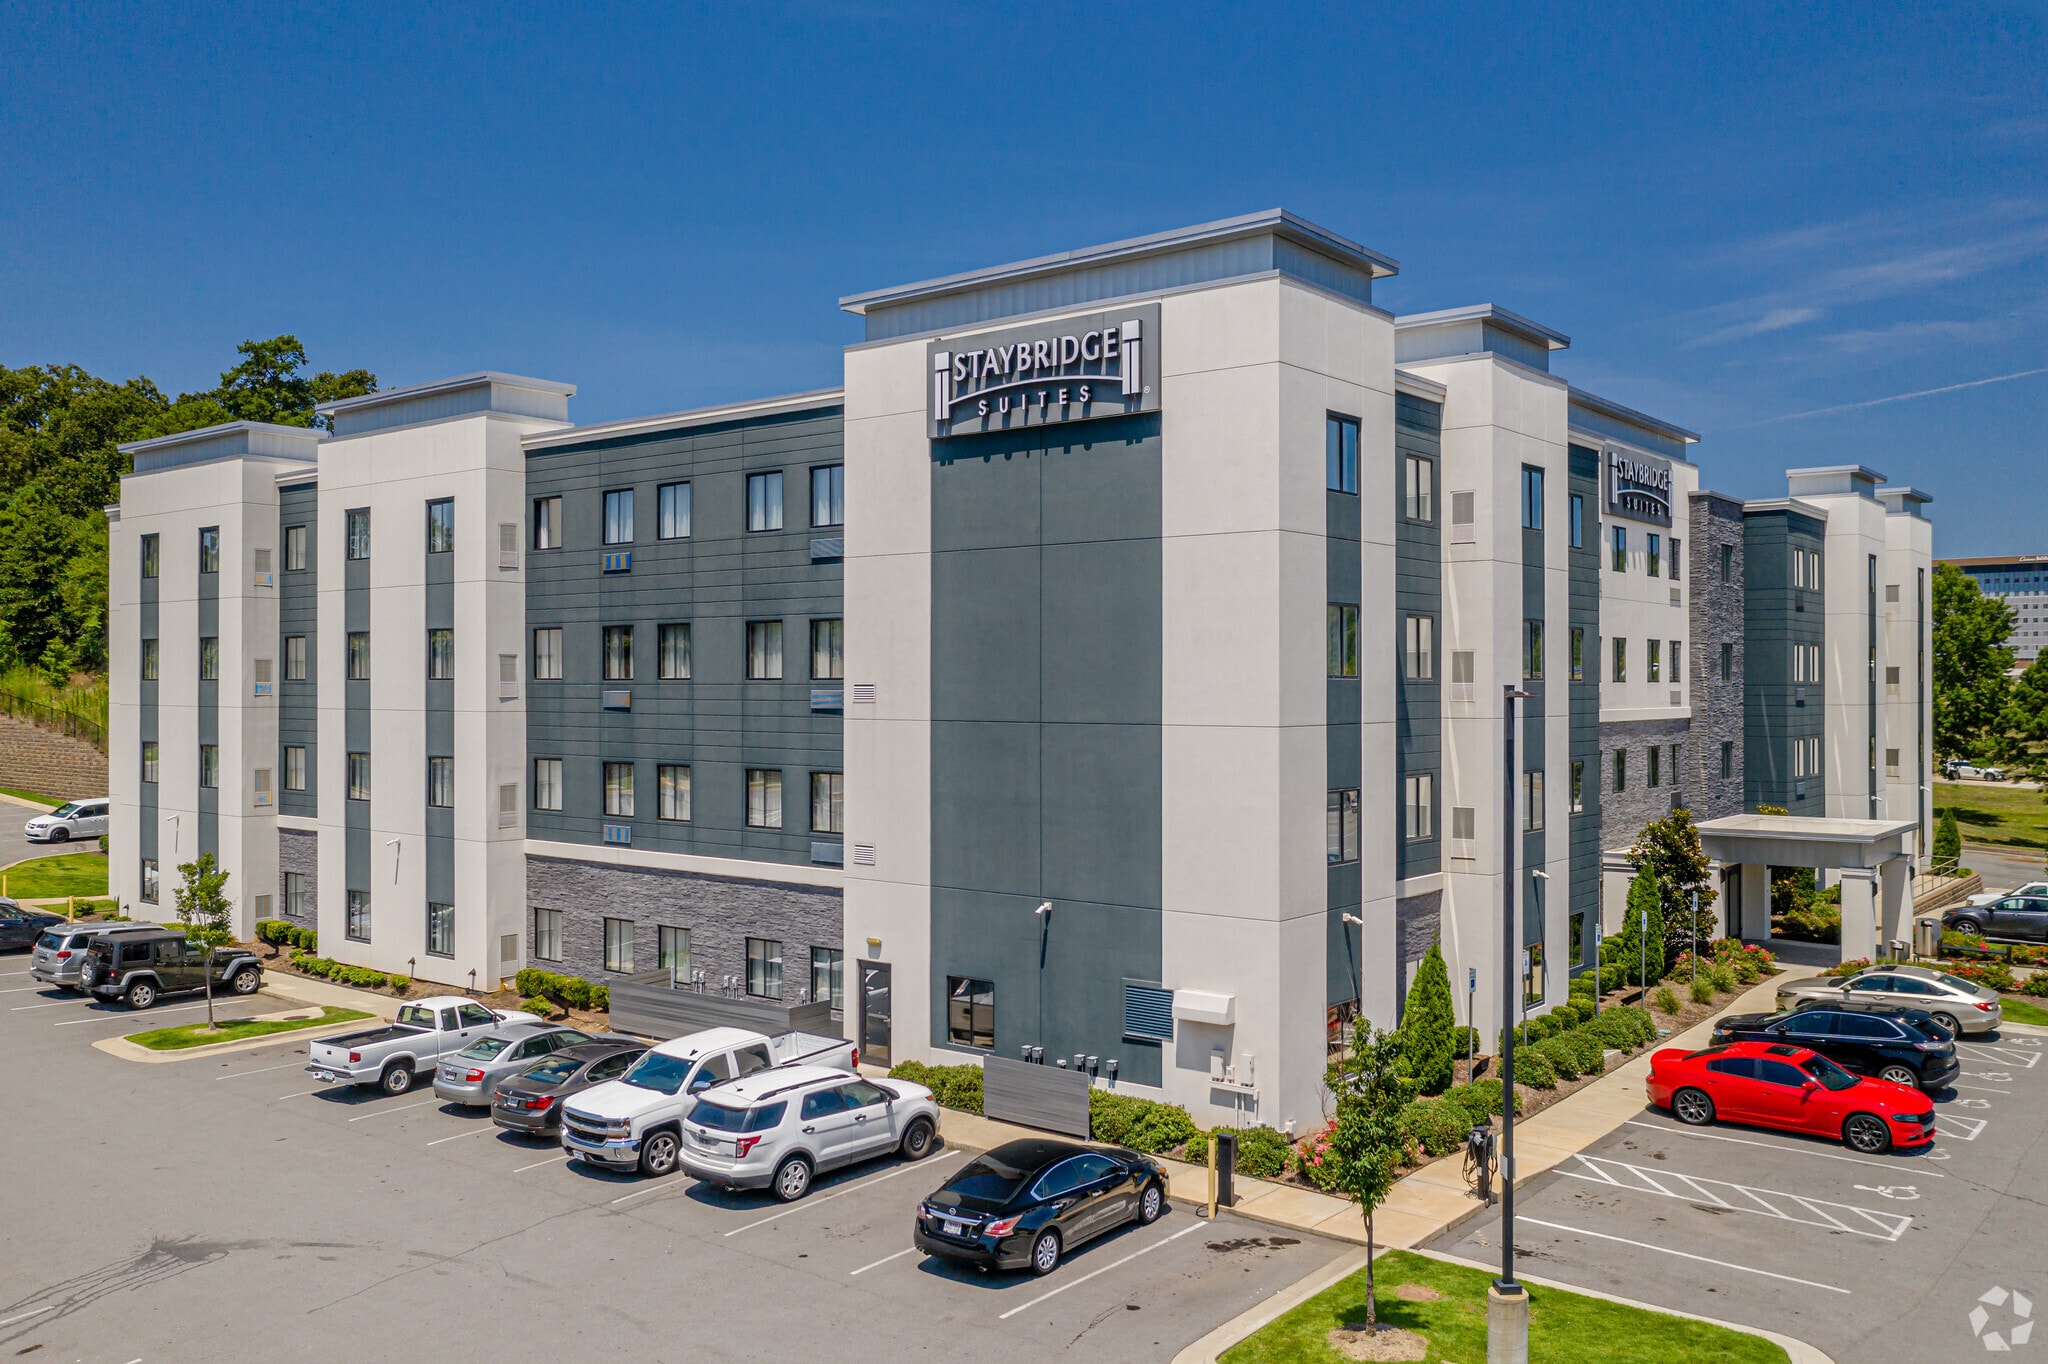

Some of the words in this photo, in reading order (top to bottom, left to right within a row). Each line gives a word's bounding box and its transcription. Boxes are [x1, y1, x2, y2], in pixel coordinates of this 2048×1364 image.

[954, 327, 1119, 382] STAYBRIDGE
[978, 385, 1092, 416] SUITES
[1618, 458, 1668, 491] STAYBRIDGE
[1626, 496, 1661, 515] SUITES
